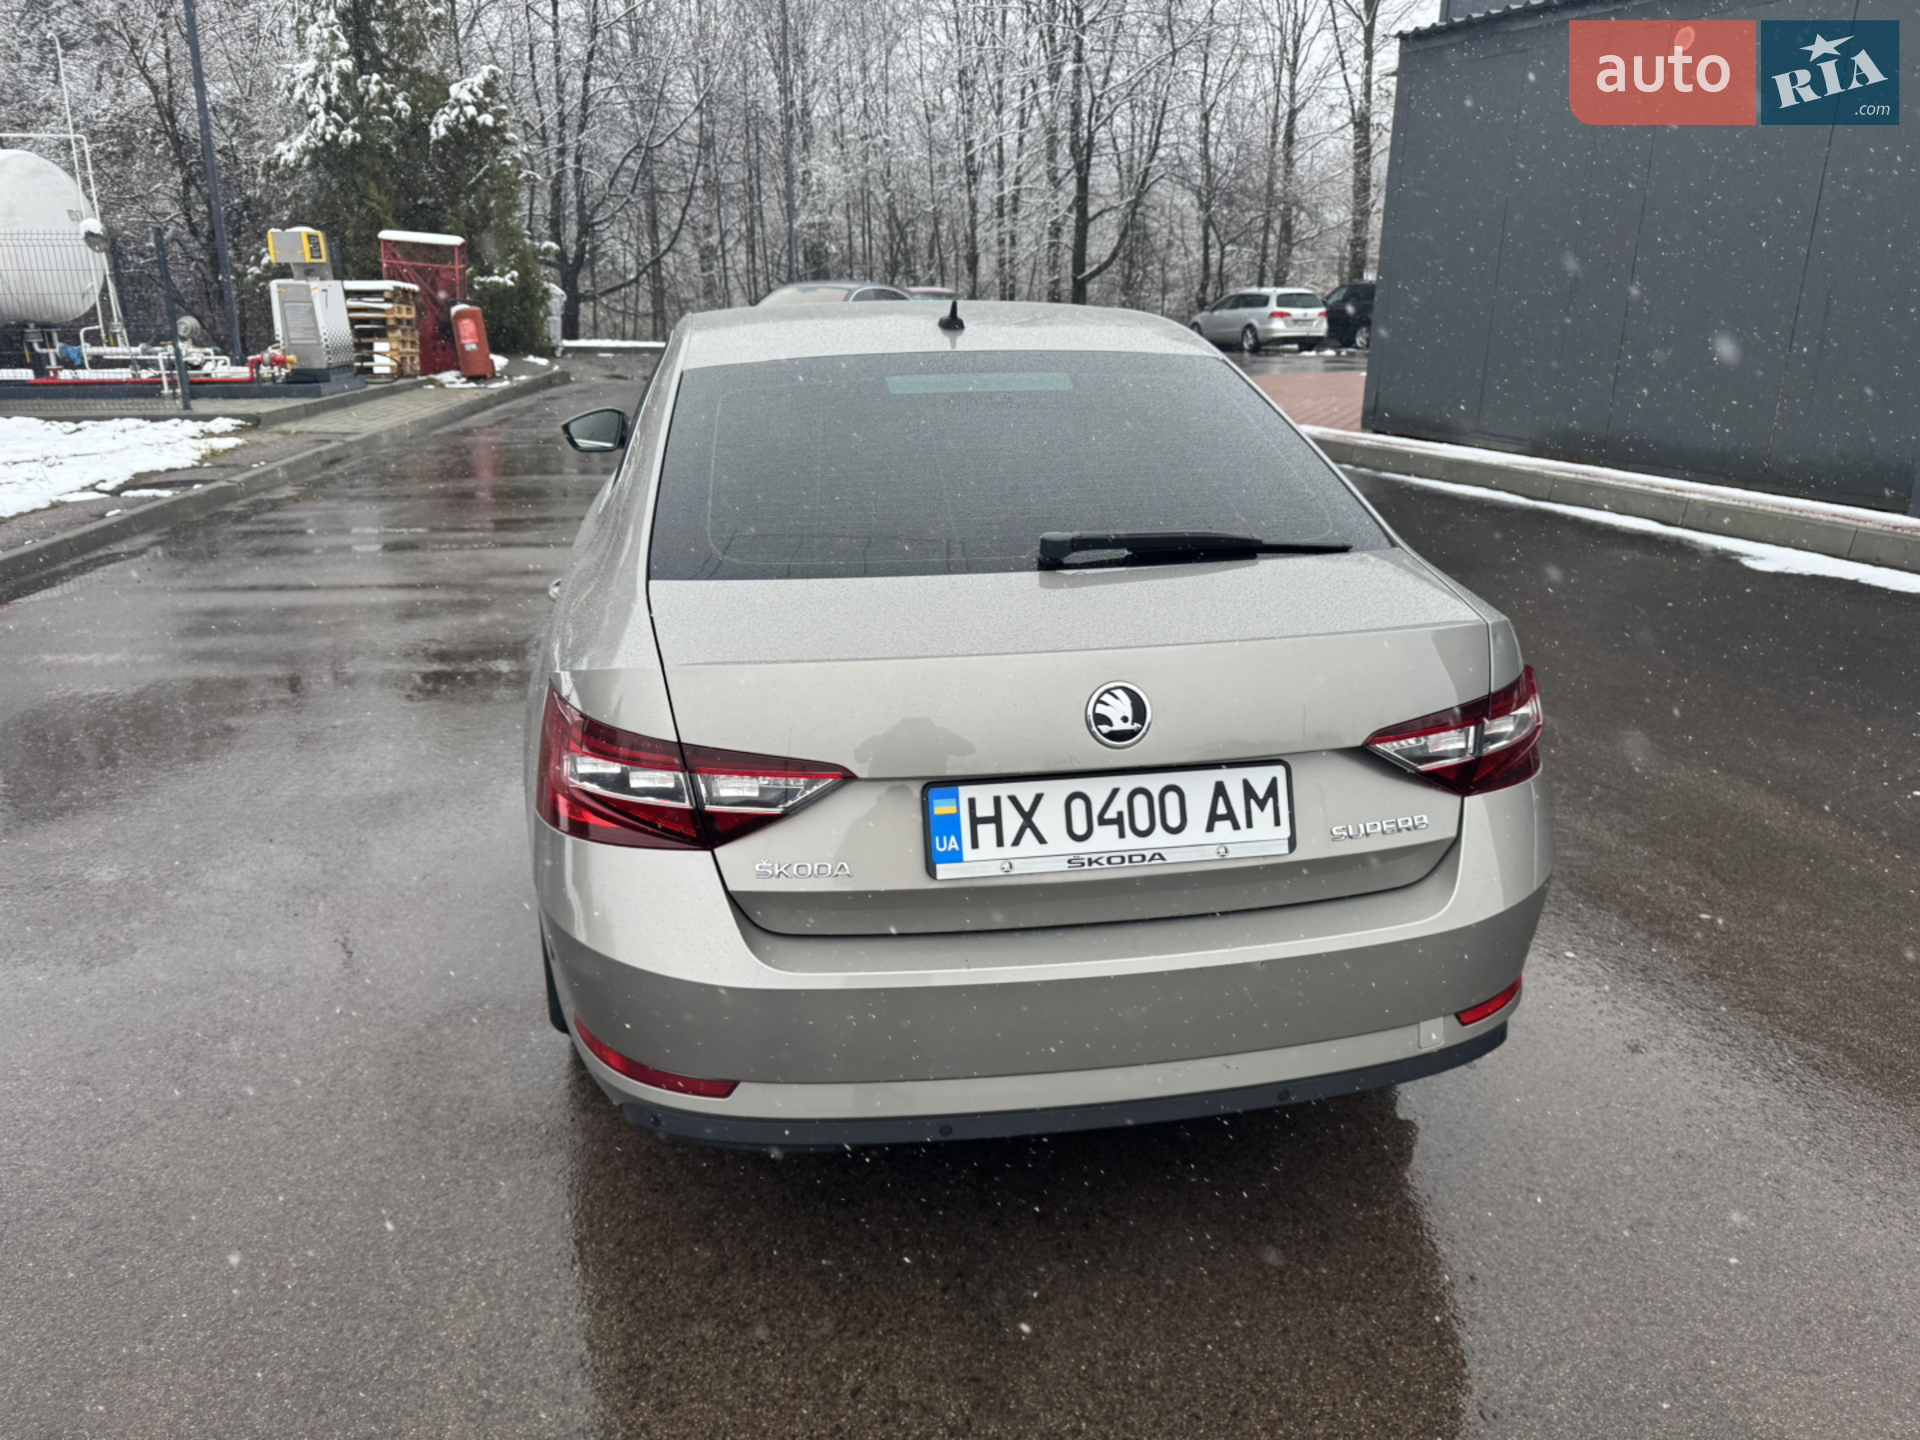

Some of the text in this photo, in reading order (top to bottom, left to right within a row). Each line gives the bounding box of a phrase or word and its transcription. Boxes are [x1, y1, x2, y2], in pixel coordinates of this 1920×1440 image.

[967, 776, 1282, 850] HX 0400 AM
[1331, 814, 1429, 842] SUPERB
[935, 835, 960, 852] UA
[755, 859, 854, 879] ŠKODA
[1066, 851, 1167, 869] ŠKODA
